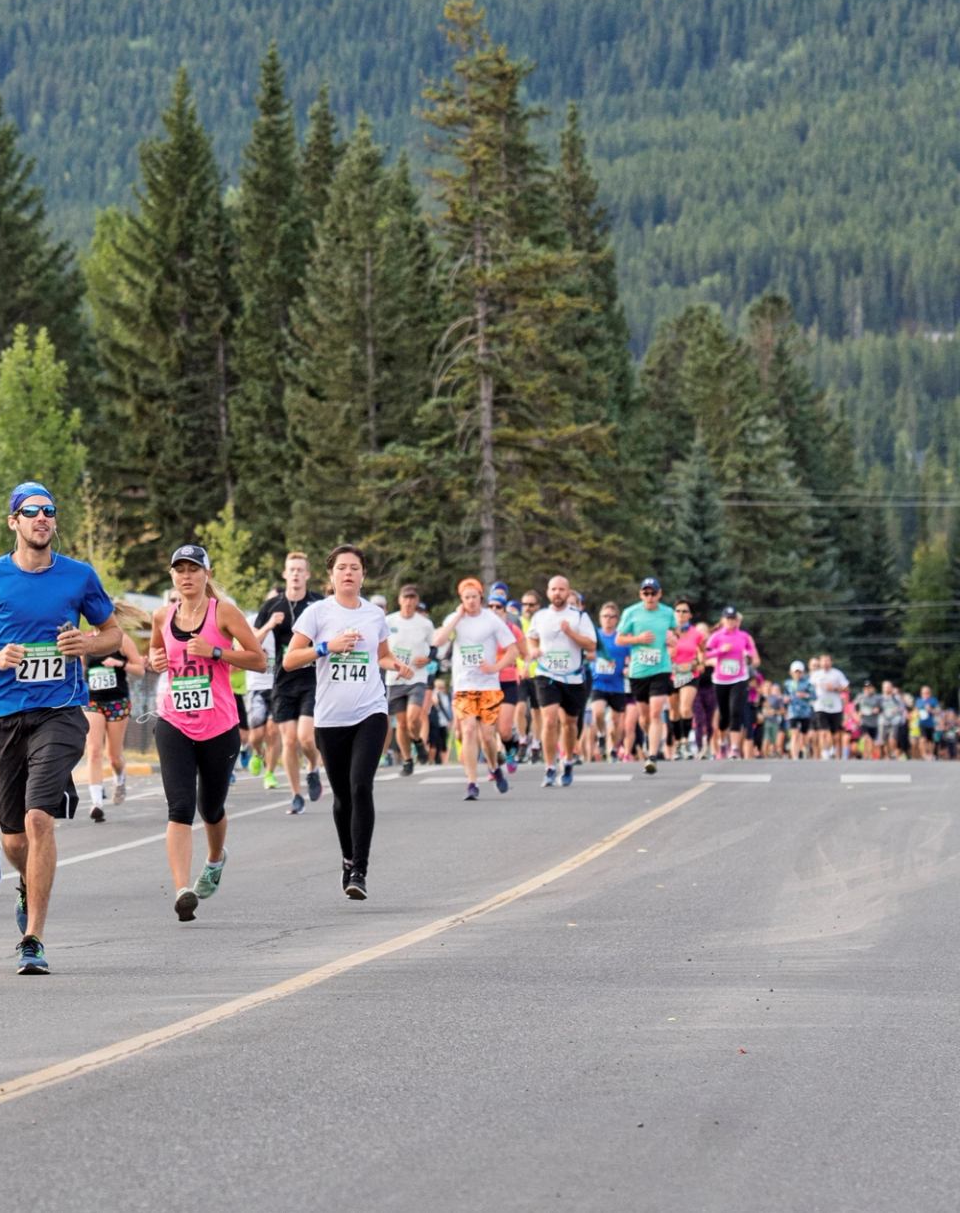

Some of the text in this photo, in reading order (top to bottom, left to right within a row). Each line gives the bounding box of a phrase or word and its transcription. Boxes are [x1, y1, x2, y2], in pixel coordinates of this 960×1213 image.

[19, 657, 62, 679] 2712
[332, 664, 366, 681] 2144
[174, 690, 209, 709] 2537
